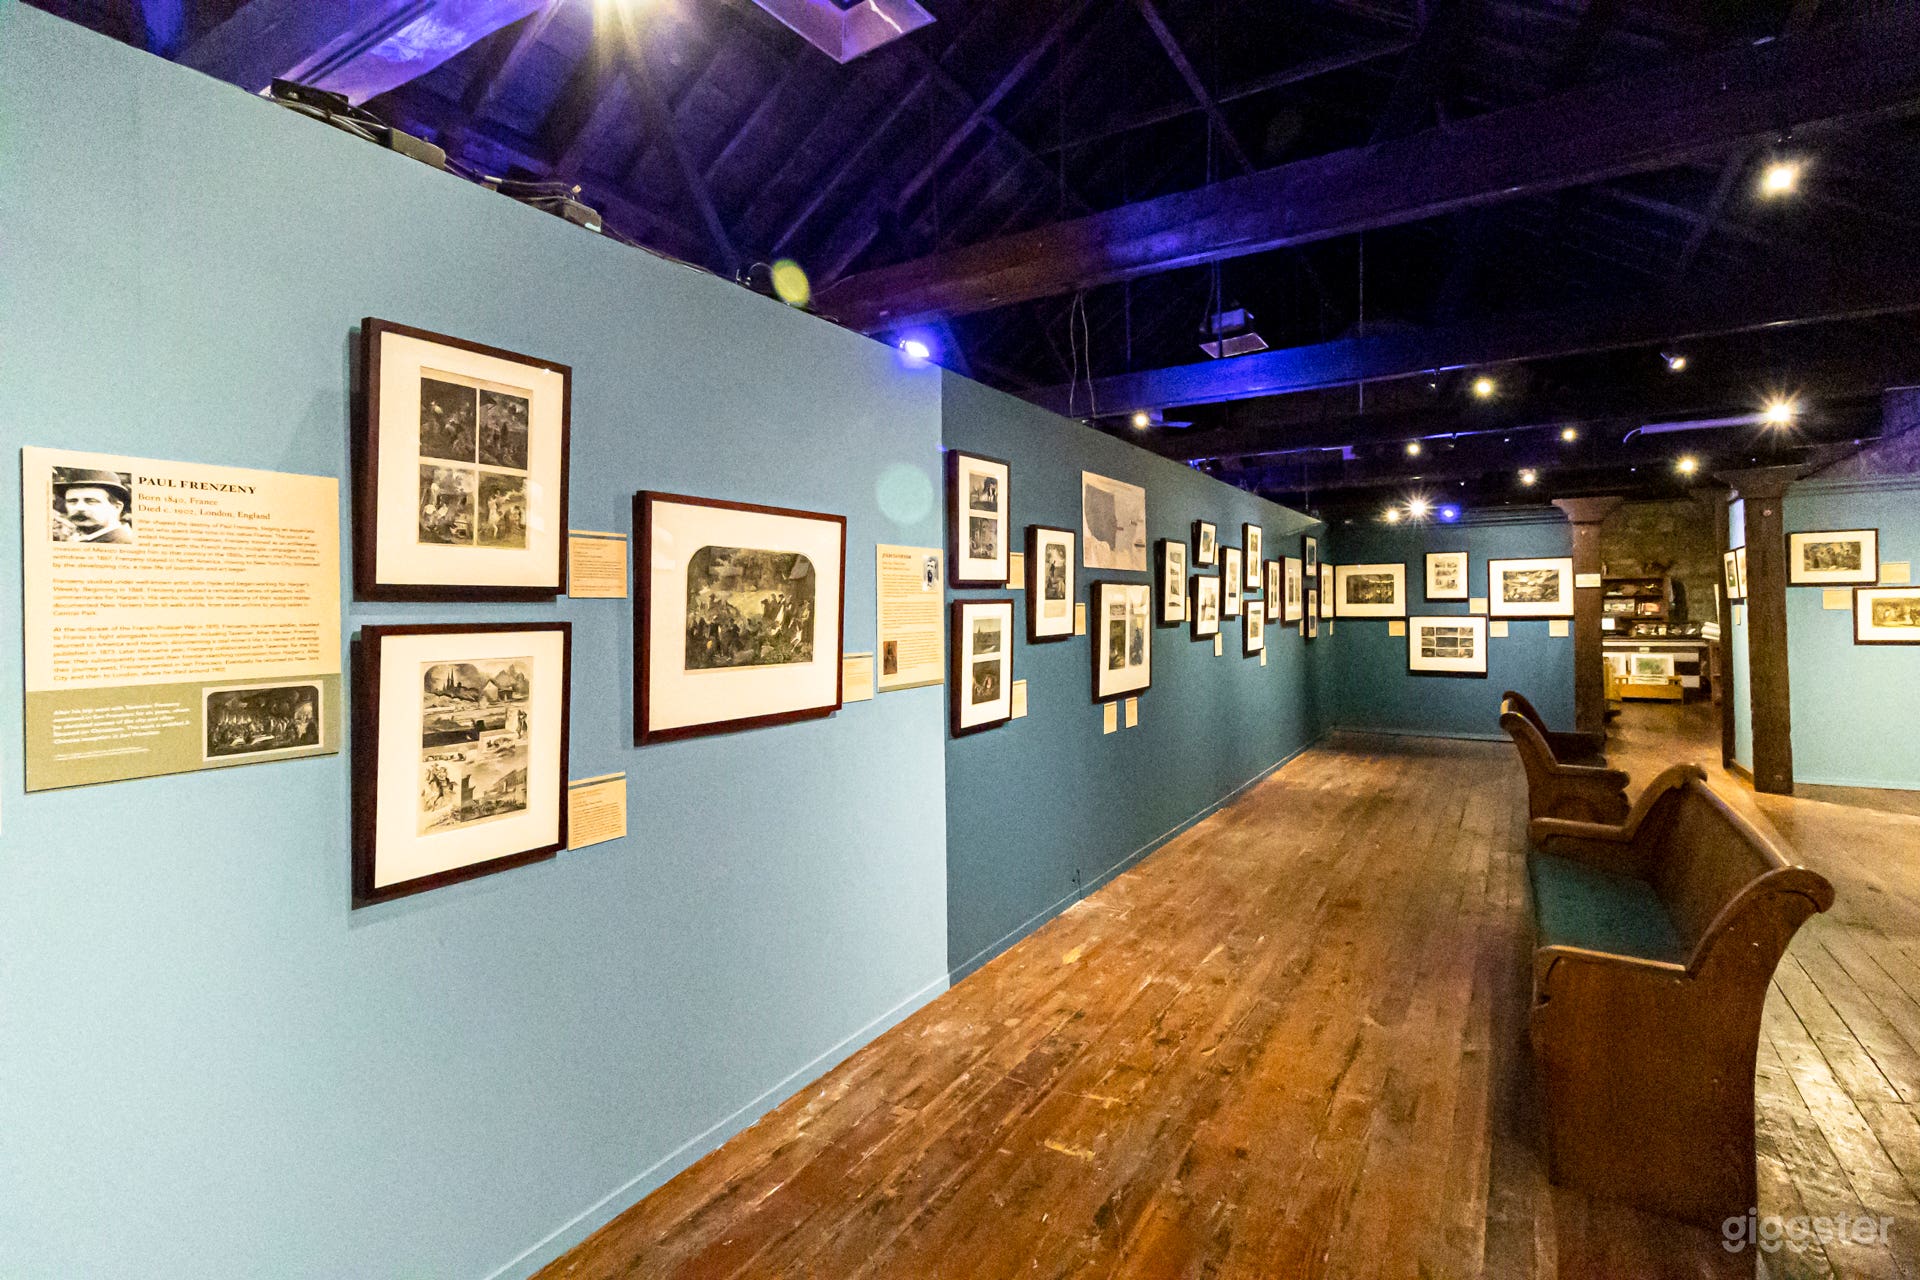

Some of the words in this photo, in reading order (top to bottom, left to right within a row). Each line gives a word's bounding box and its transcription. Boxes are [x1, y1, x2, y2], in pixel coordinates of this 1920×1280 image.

[138, 477, 177, 488] PAUL
[181, 480, 257, 495] FRENZENY
[138, 493, 161, 502] Born
[190, 497, 219, 506] France
[138, 504, 161, 513] Died
[237, 511, 271, 521] England
